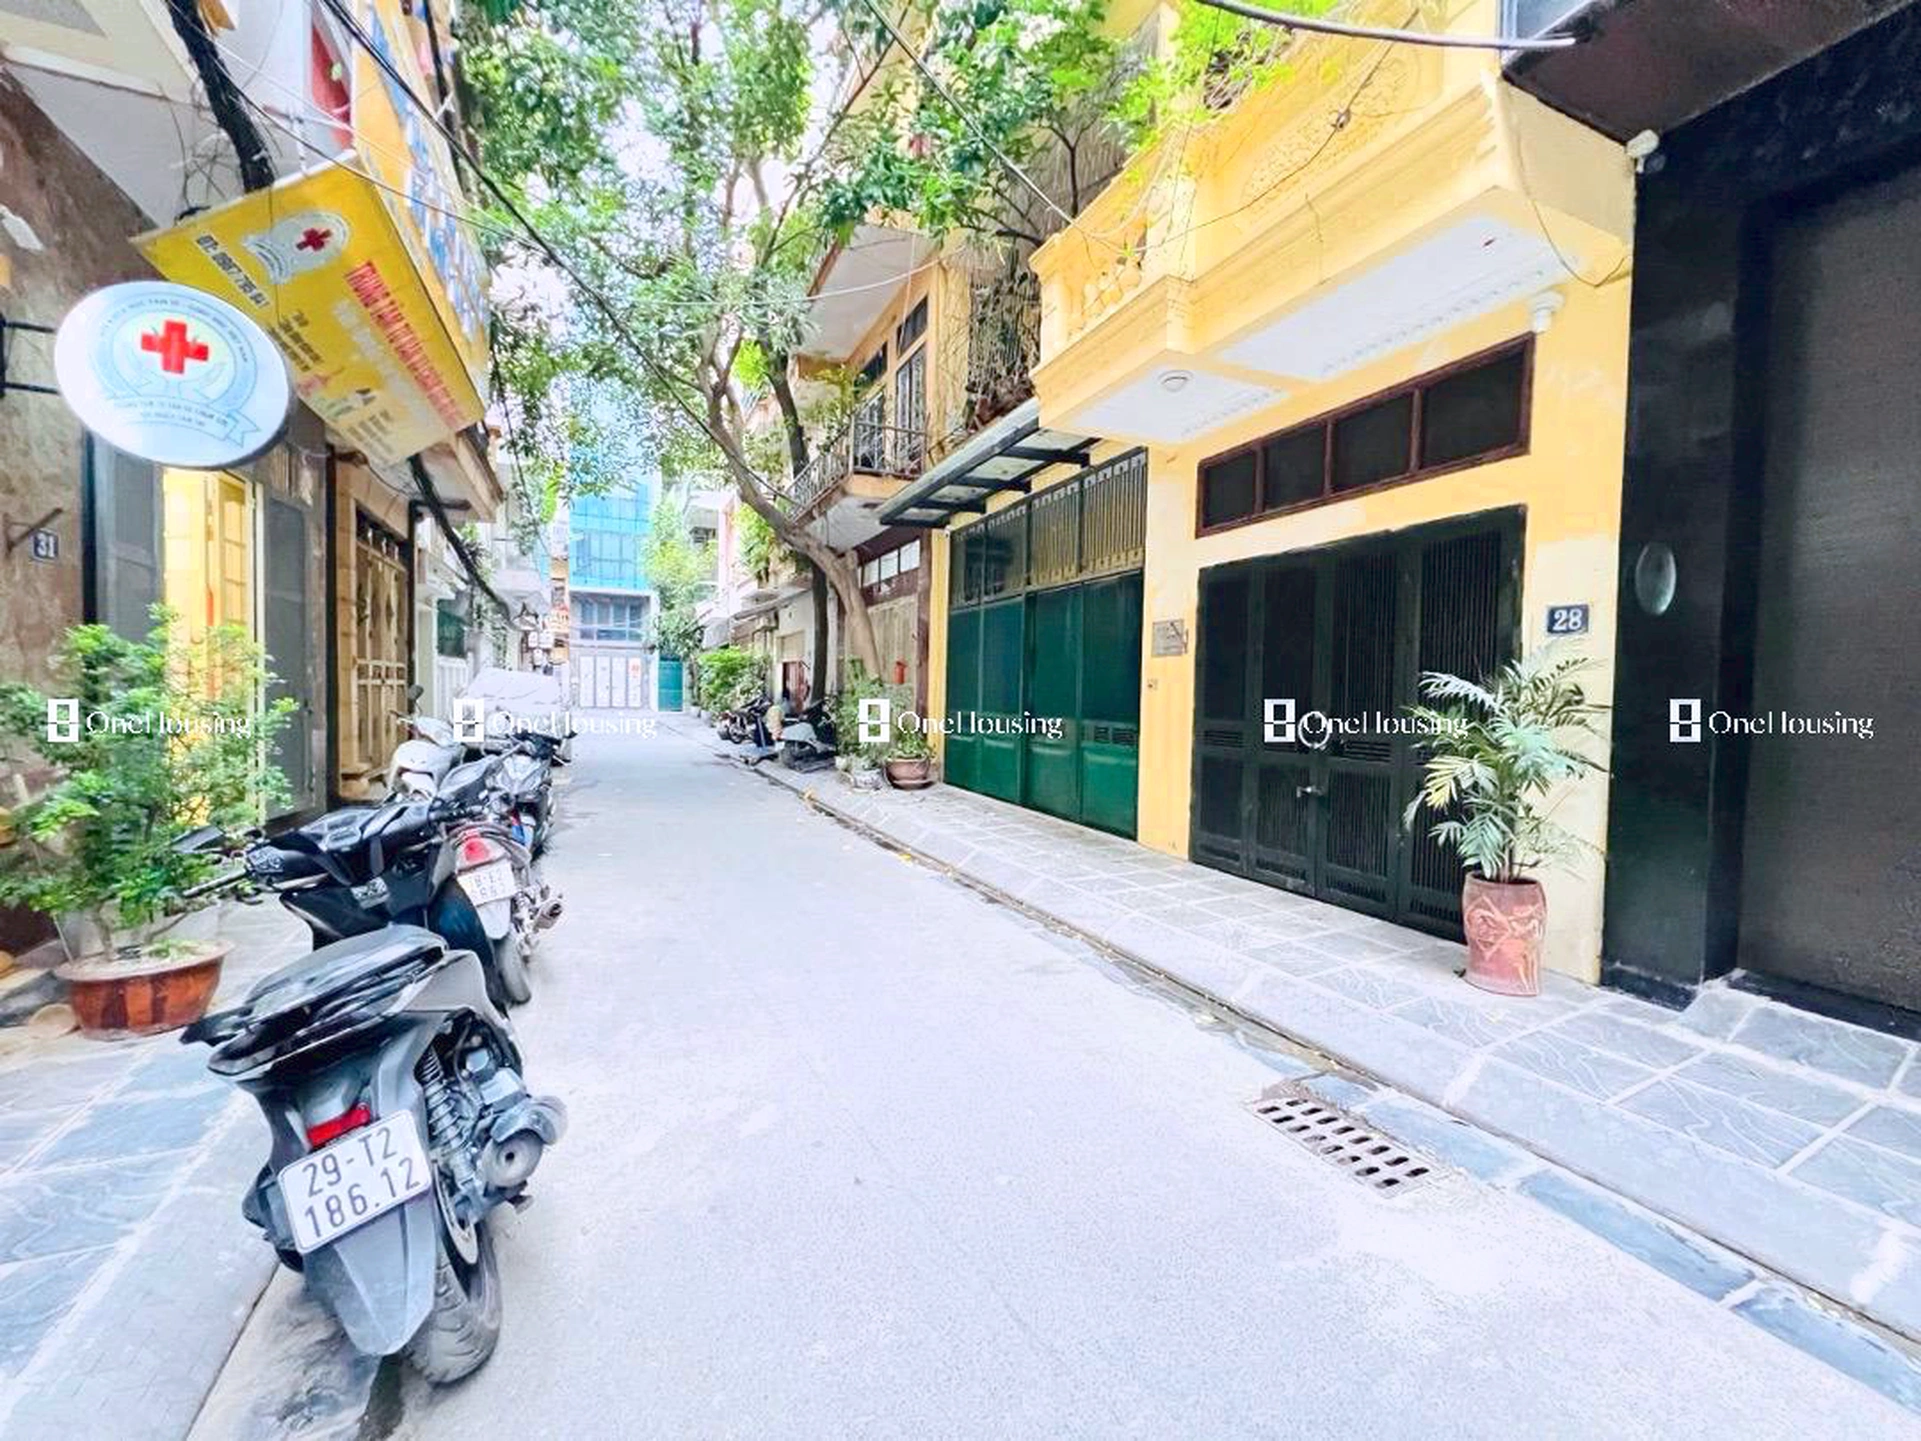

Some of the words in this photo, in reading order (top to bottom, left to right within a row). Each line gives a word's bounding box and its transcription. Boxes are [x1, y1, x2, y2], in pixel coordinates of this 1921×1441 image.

[1552, 608, 1582, 632] 28
[302, 1126, 398, 1198] 29-T2
[305, 1156, 421, 1238] 186.12
